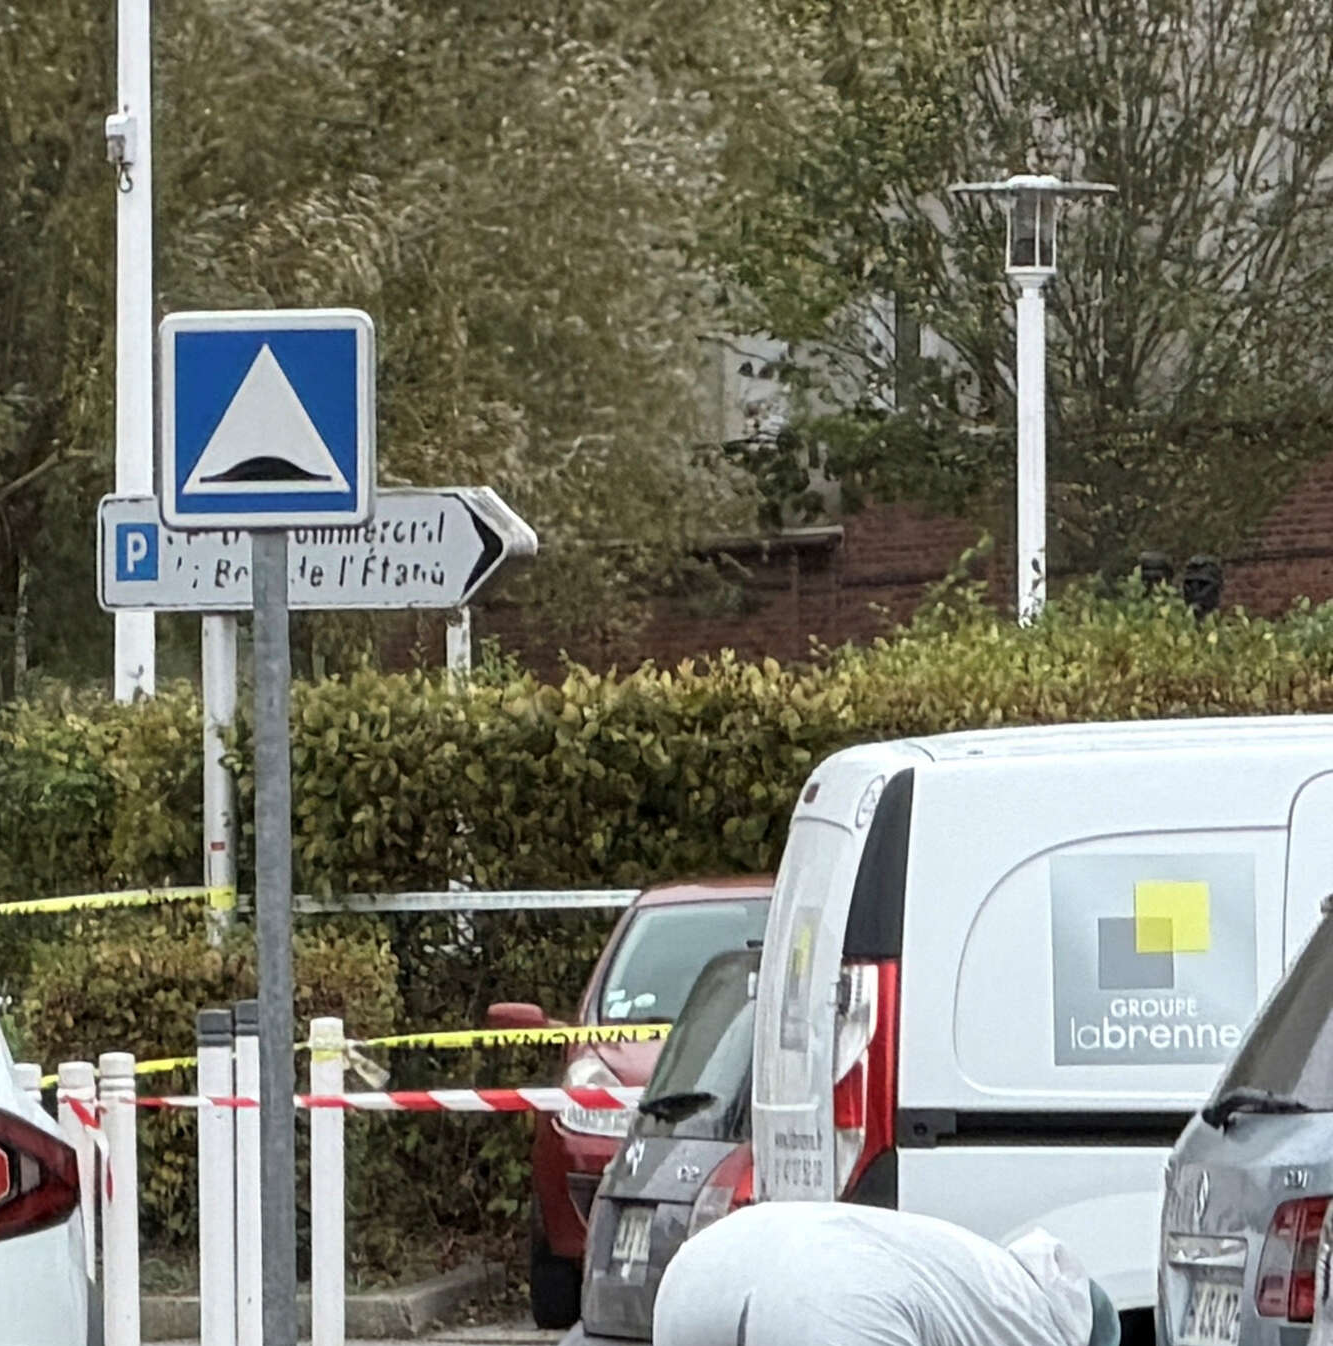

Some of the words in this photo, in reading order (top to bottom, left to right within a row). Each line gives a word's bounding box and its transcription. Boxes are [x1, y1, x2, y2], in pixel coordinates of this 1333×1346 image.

[127, 531, 148, 574] P
[1110, 998, 1198, 1018] GROUPE
[1070, 1016, 1241, 1050] labrenne
